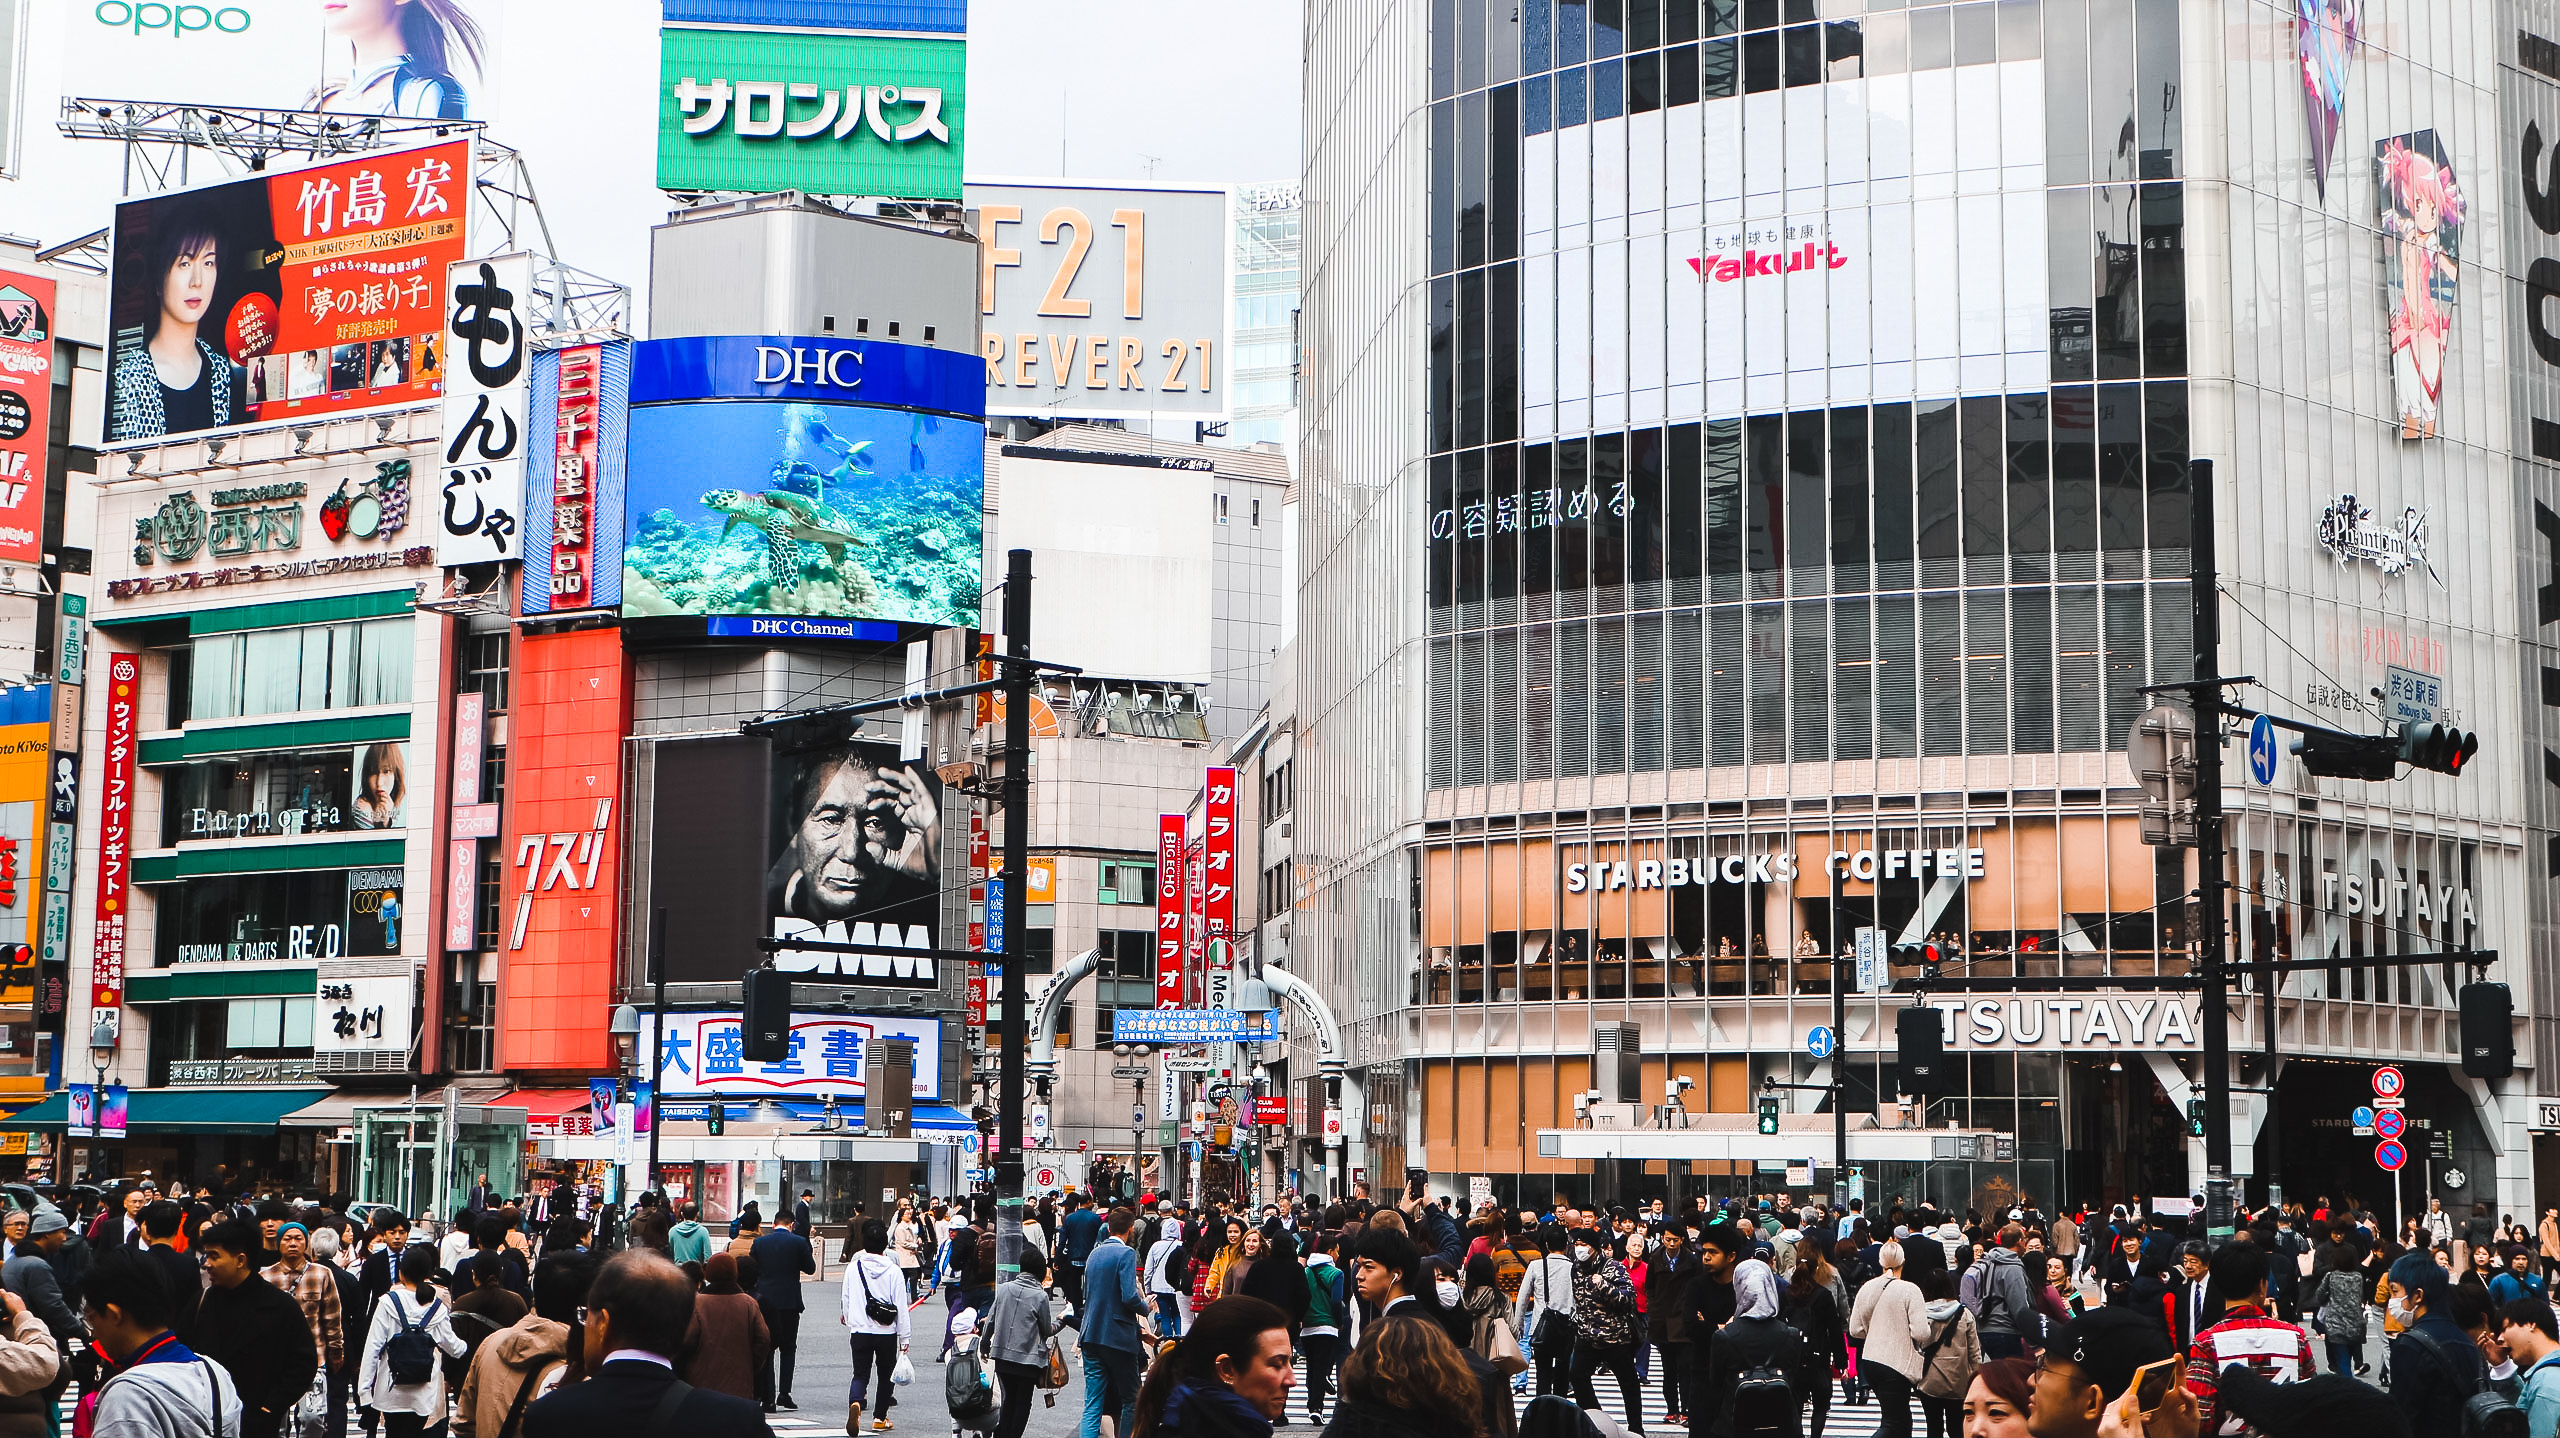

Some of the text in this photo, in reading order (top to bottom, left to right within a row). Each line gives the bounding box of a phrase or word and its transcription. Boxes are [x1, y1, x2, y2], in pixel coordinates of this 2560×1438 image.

[95, 0, 250, 38] oppo
[674, 78, 949, 144] サロンパス
[296, 158, 452, 237] 竹島 宏
[978, 204, 1145, 320] F21
[1686, 240, 1848, 283] Yakult
[1697, 224, 1832, 253] も地球も健康に
[304, 274, 432, 326] 「夢の振り子」
[336, 317, 398, 341] 好評発売中
[754, 346, 864, 388] DHC
[1160, 338, 1212, 393] 21
[446, 262, 523, 553] もんじゃ
[550, 354, 591, 596] 三千里薬品
[1160, 458, 1211, 471] デザイン製作中
[208, 501, 304, 558] 西村
[1431, 481, 1635, 539] の容疑認める
[751, 618, 853, 637] DHC Channel
[2390, 673, 2439, 708] 渋谷駅前
[2397, 702, 2421, 719] Shibuya
[458, 699, 478, 798] お好み焼
[105, 701, 130, 896] ウィンターフルーツギフト
[190, 800, 341, 838] Euphoria
[51, 841, 60, 875] パーラー
[60, 836, 69, 871] フルーツ
[1162, 831, 1177, 898] BIG ECHO
[1207, 784, 1232, 903] カラオケ
[352, 869, 403, 891] DENDAMA
[450, 843, 471, 946] もんじゃ焼
[510, 797, 613, 951] クスリ
[1567, 847, 1985, 893] STARBUCKS COFFEE
[2321, 871, 2477, 926] TSUTAYA
[108, 914, 124, 991] 無料配送地域
[178, 941, 277, 963] DENDAMA & DARTS
[288, 923, 340, 960] RE/D
[774, 916, 935, 979] DMM
[989, 885, 1004, 972] 大盛堂商事ル
[1159, 911, 1181, 1010] カラオケ
[332, 1004, 384, 1040] 松川
[1031, 970, 1065, 1037] 渋谷センター街
[1118, 1019, 1272, 1031] この社会あなたの税がいきる
[1290, 988, 1329, 1050] 渋谷センター街
[1932, 999, 2195, 1044] TSUTAYA
[172, 1064, 314, 1080] 渋谷西村 フルーツパーラー
[662, 1108, 703, 1116] TAISEIDO
